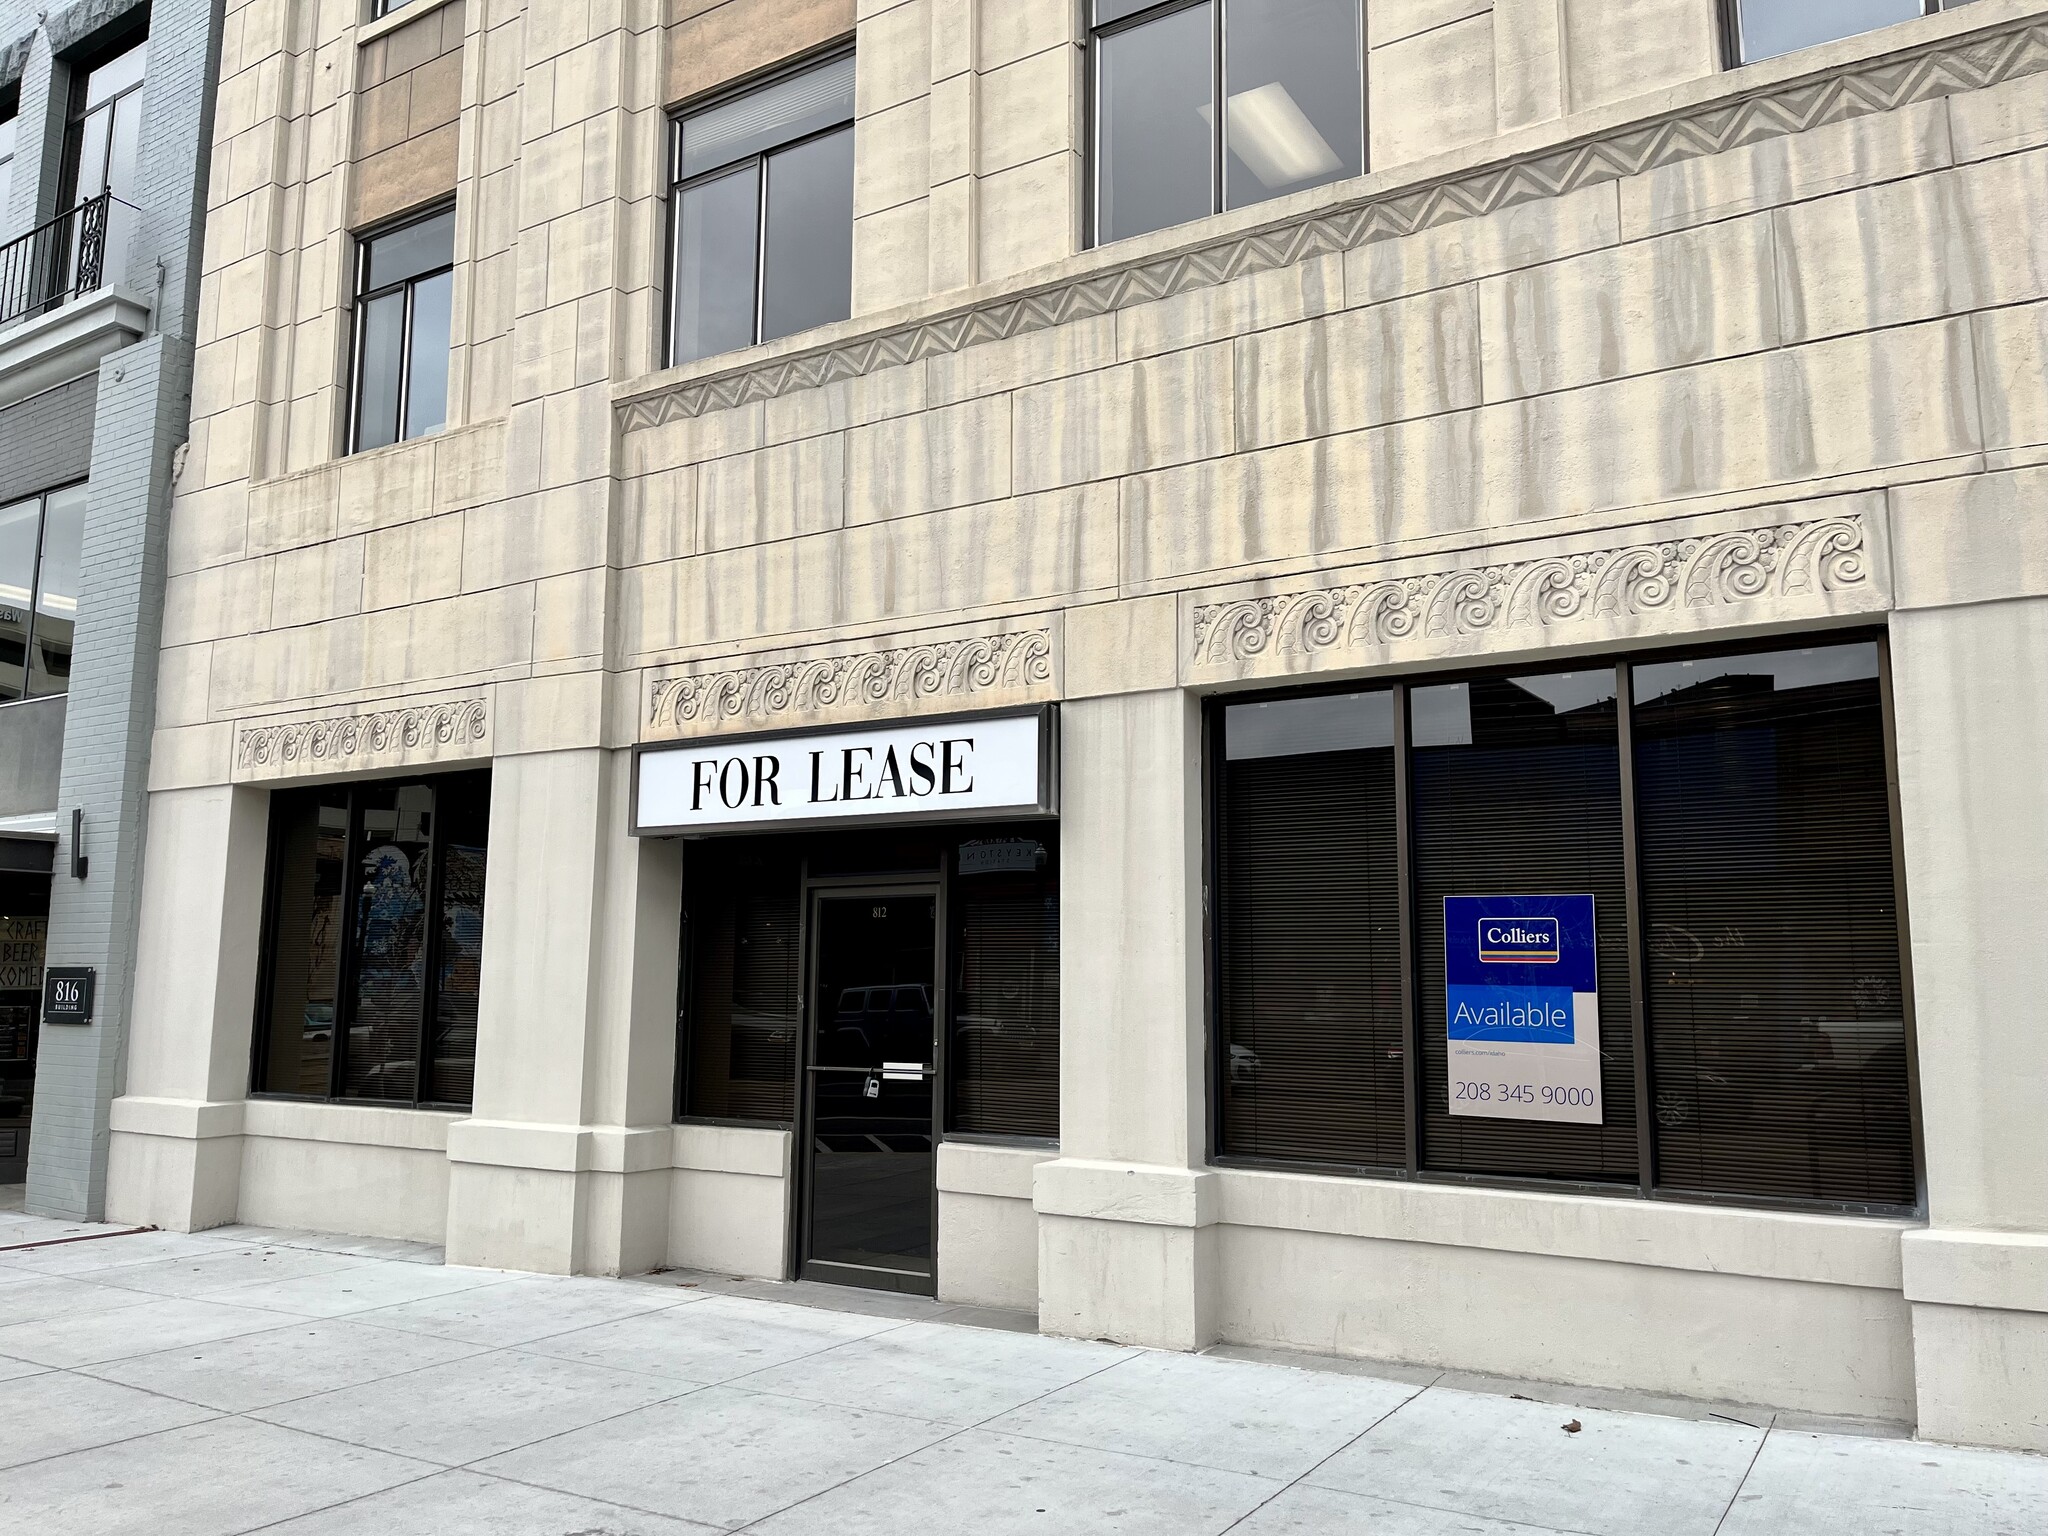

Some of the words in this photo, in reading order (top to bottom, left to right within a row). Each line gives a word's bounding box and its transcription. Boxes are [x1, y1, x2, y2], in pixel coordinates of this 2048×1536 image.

[690, 755, 782, 811] FOR
[807, 738, 975, 803] LEASE
[872, 906, 887, 918] 812
[1487, 927, 1550, 944] Colliers
[2, 942, 39, 962] BEER
[55, 980, 79, 1002] 816
[54, 1003, 78, 1011] BUILDING
[1454, 1001, 1567, 1028] Available
[1454, 1048, 1506, 1057] colliers.com/idaho
[1455, 1081, 1491, 1101] 208
[1498, 1083, 1535, 1104] 345
[1541, 1085, 1594, 1107] 9000
